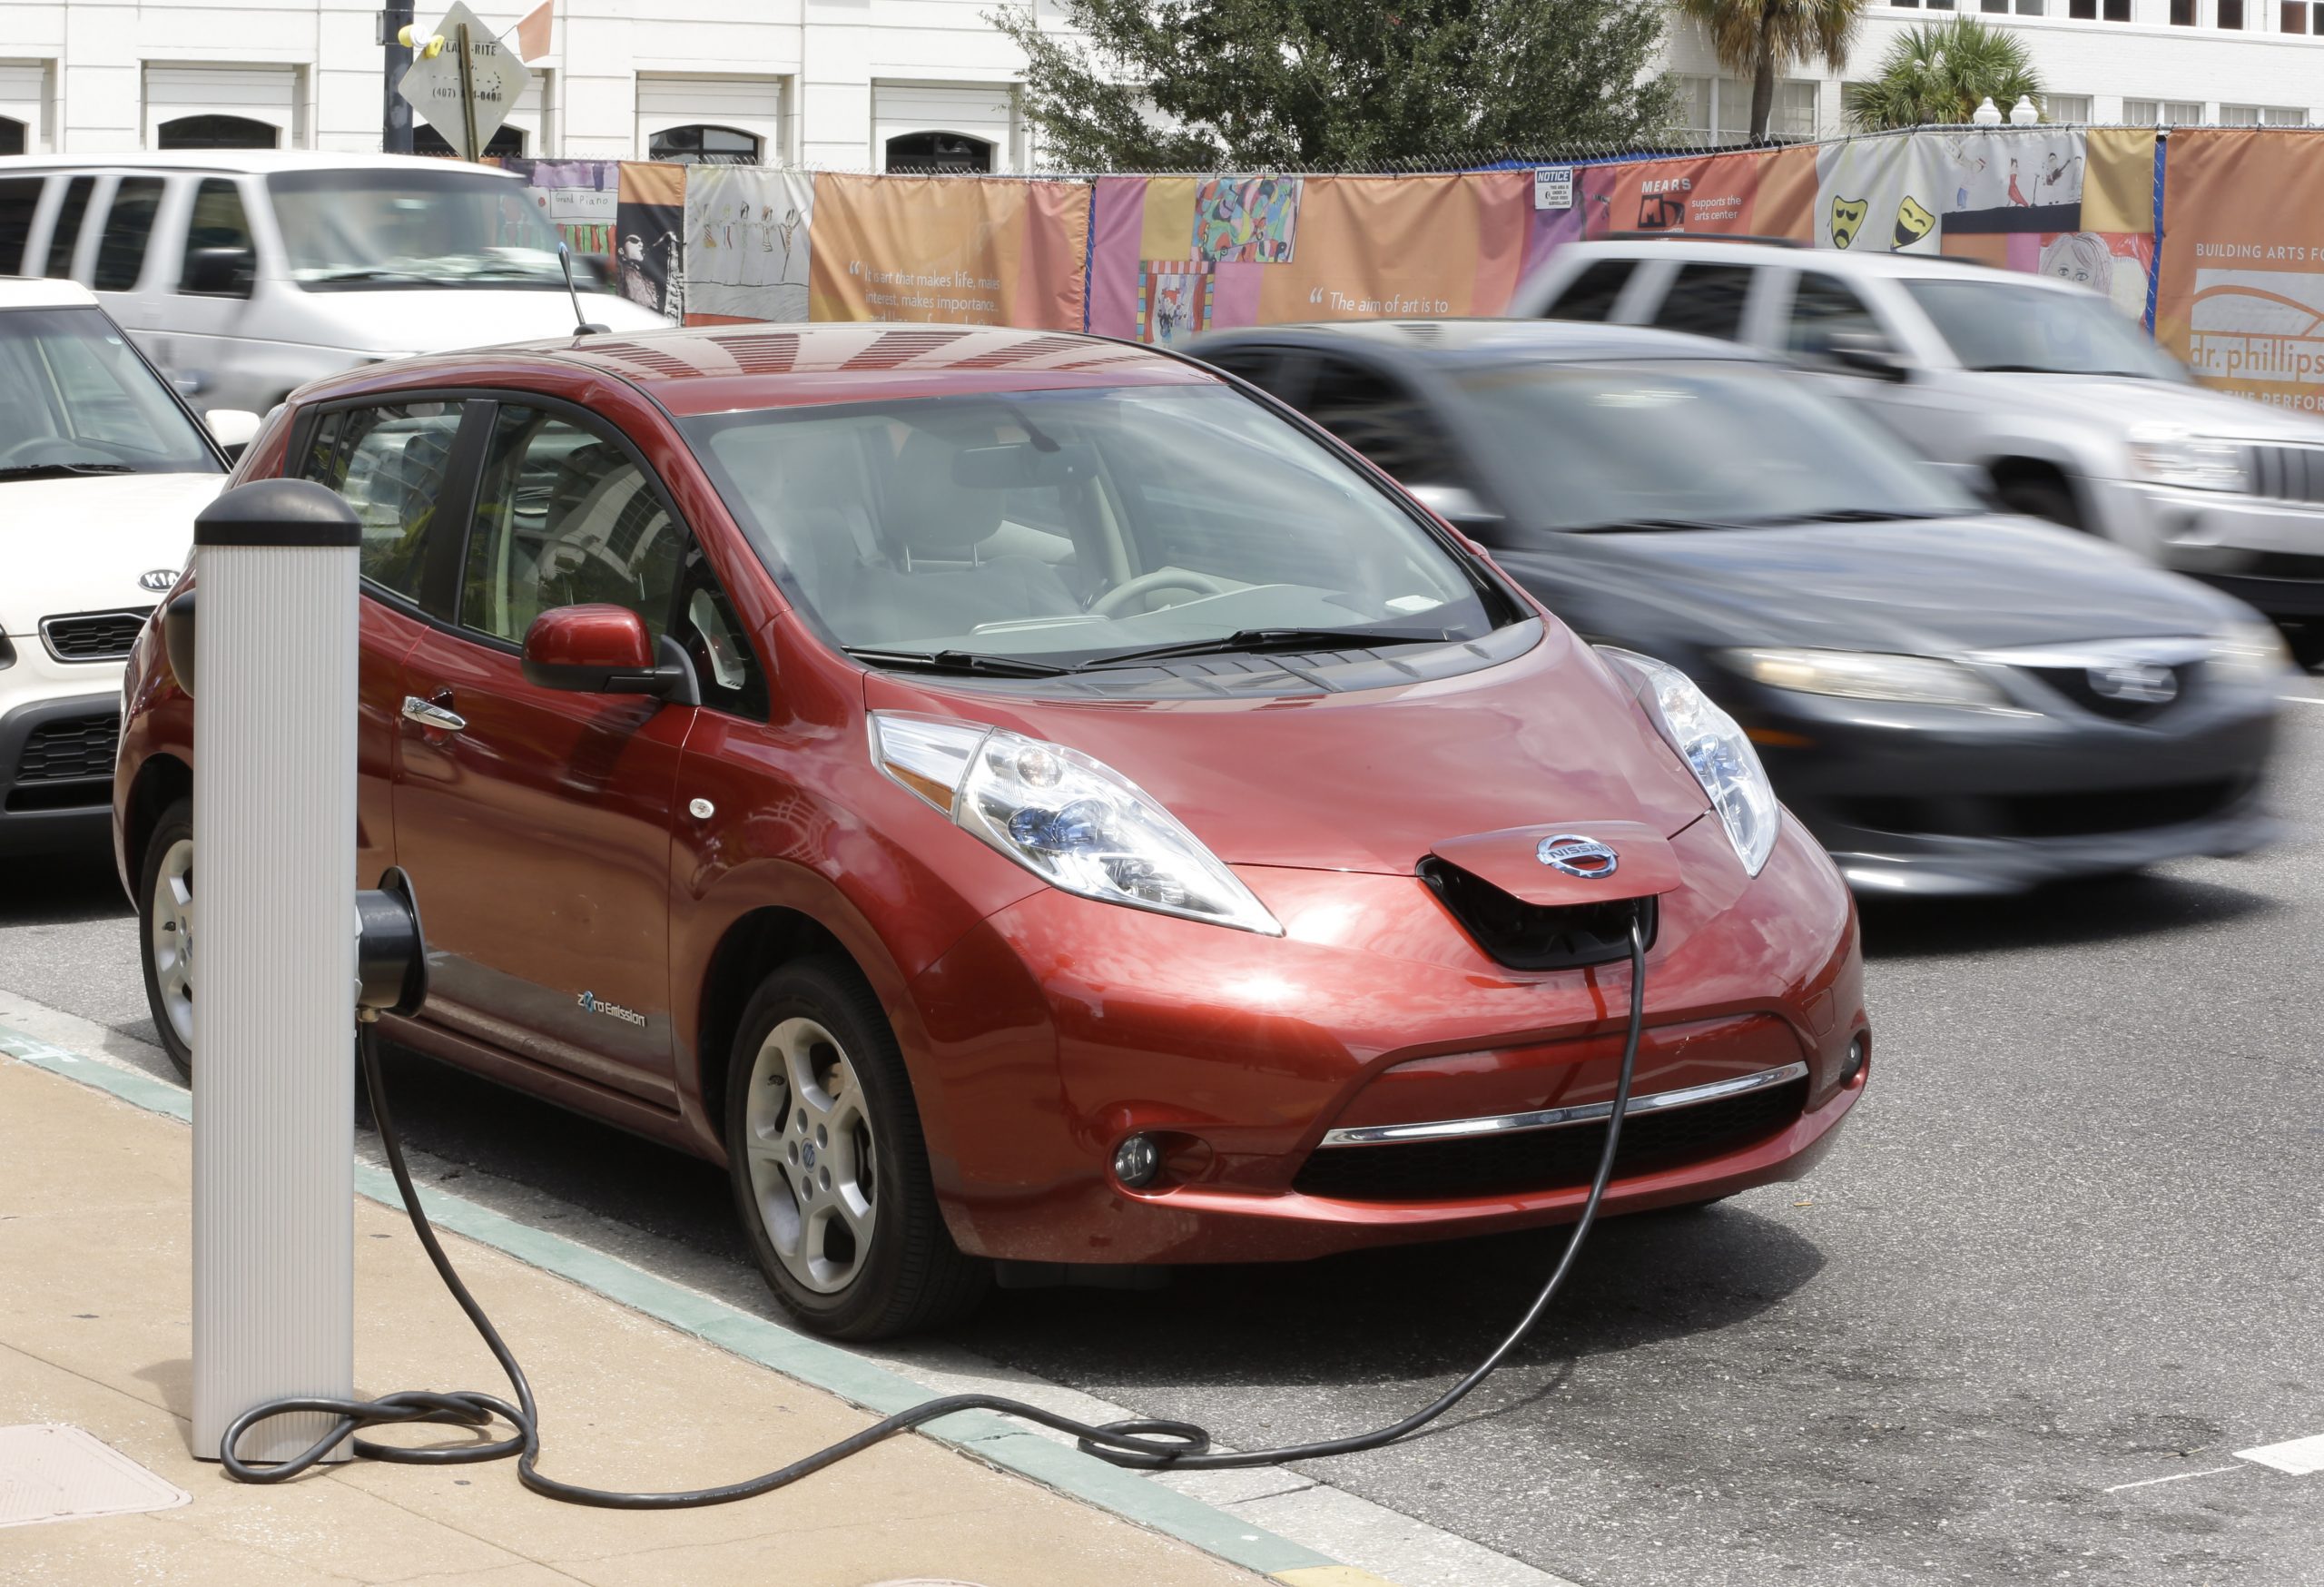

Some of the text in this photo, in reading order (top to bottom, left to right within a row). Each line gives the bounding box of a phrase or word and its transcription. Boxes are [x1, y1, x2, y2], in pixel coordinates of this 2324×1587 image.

[439, 42, 496, 56] LA-RITE
[432, 87, 456, 98] (407)
[1538, 171, 1570, 182] NOTICE
[1641, 178, 1691, 192] MEARS
[556, 192, 608, 205] Grand Piano
[1691, 194, 1741, 210] supports the
[1694, 210, 1738, 222] arts center
[2196, 243, 2261, 259] BUILDING
[2266, 246, 2305, 261] ARTS
[881, 272, 892, 283] art
[895, 269, 914, 285] that
[917, 270, 950, 287] makes
[955, 271, 975, 290] life,
[901, 291, 934, 308] makes
[1330, 291, 1354, 310] The
[1358, 297, 1381, 312] aim
[1384, 294, 1400, 312] of
[1402, 299, 1419, 313] art
[1421, 297, 1431, 312] is
[1434, 299, 1448, 313] to
[2191, 336, 2324, 382] dr. phillips
[1548, 844, 1612, 858] NISSAN
[605, 1001, 645, 1027] Emission
